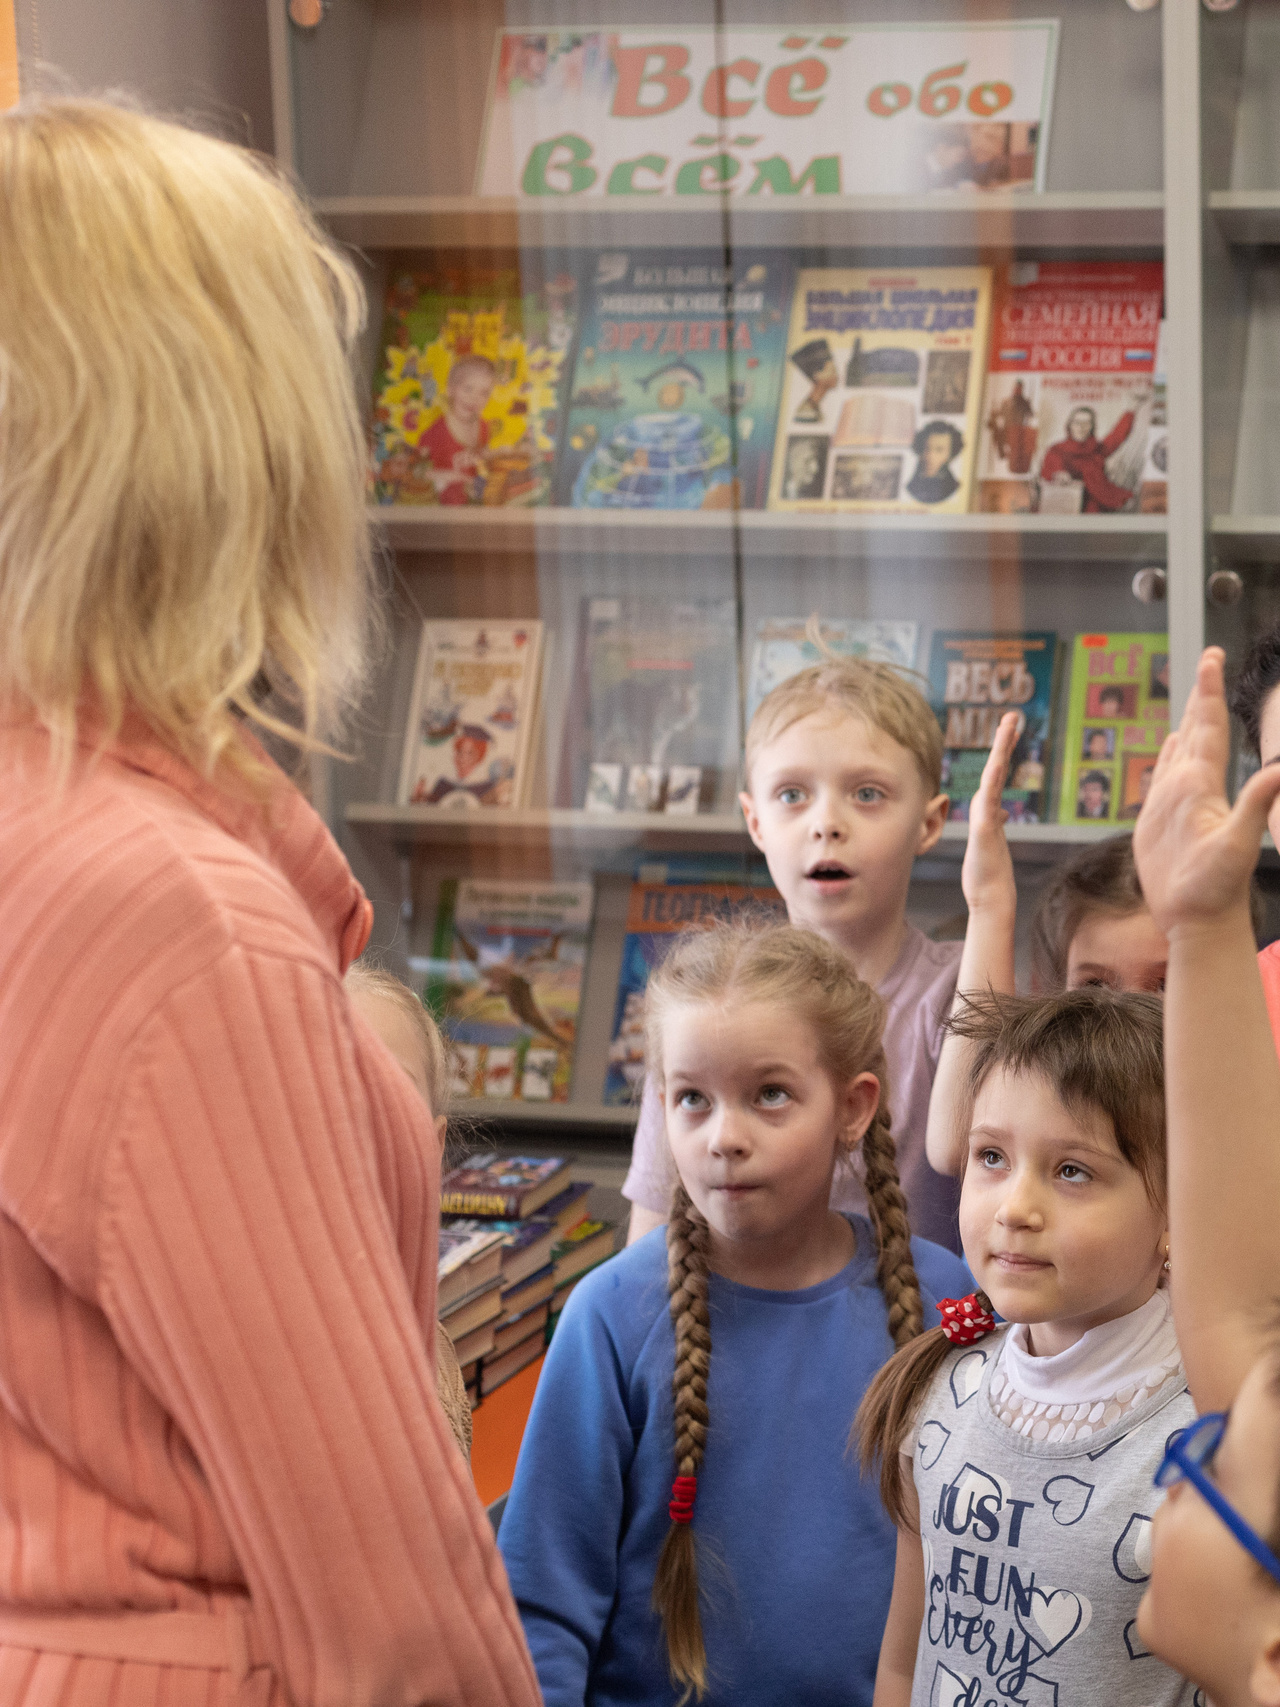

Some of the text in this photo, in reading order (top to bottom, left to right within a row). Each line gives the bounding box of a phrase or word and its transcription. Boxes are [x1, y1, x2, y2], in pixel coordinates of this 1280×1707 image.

[609, 36, 1013, 118] Всё обо
[599, 320, 752, 354] ЭРУДИТА
[944, 660, 1035, 704] ВЕСЬ
[933, 1483, 1035, 1548] JUST
[949, 1546, 1036, 1618] FUN
[928, 1572, 1045, 1697] Every
